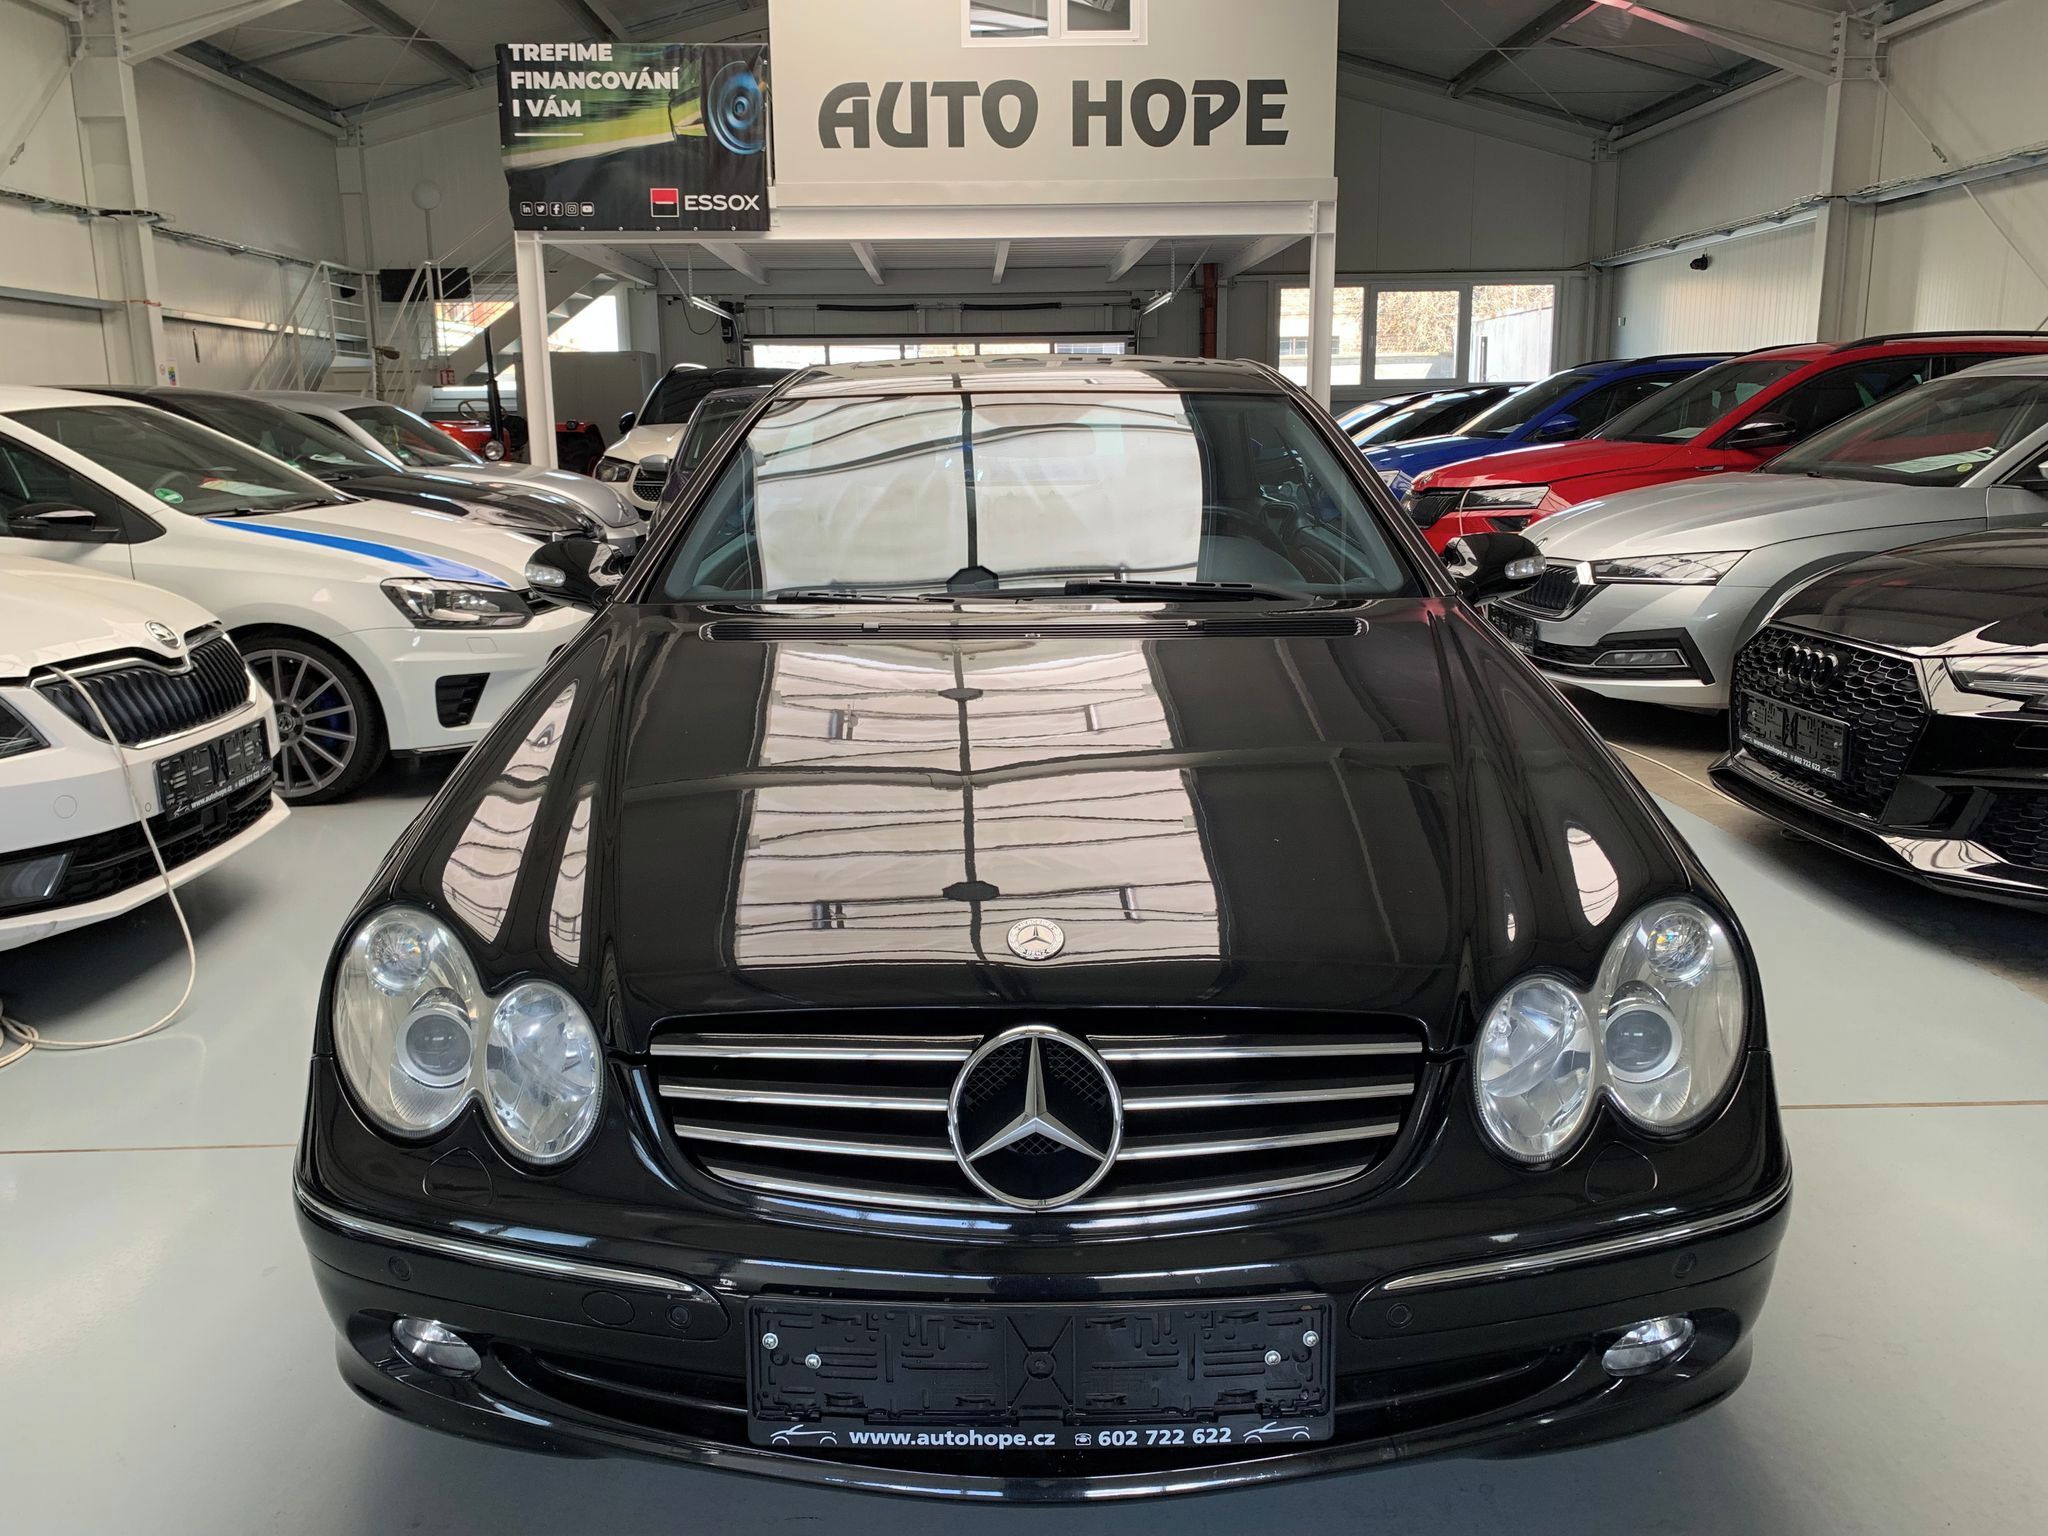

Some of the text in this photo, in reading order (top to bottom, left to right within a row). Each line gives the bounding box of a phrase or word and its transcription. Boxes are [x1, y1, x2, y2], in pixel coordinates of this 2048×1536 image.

[510, 66, 680, 90] FINANCOVÁNÍ
[512, 95, 582, 117] I VÁM
[817, 78, 1289, 149] AUTO HOPE
[684, 194, 760, 211] ESSOX
[849, 1427, 1232, 1449] www.autohope.cz 602 722 622
